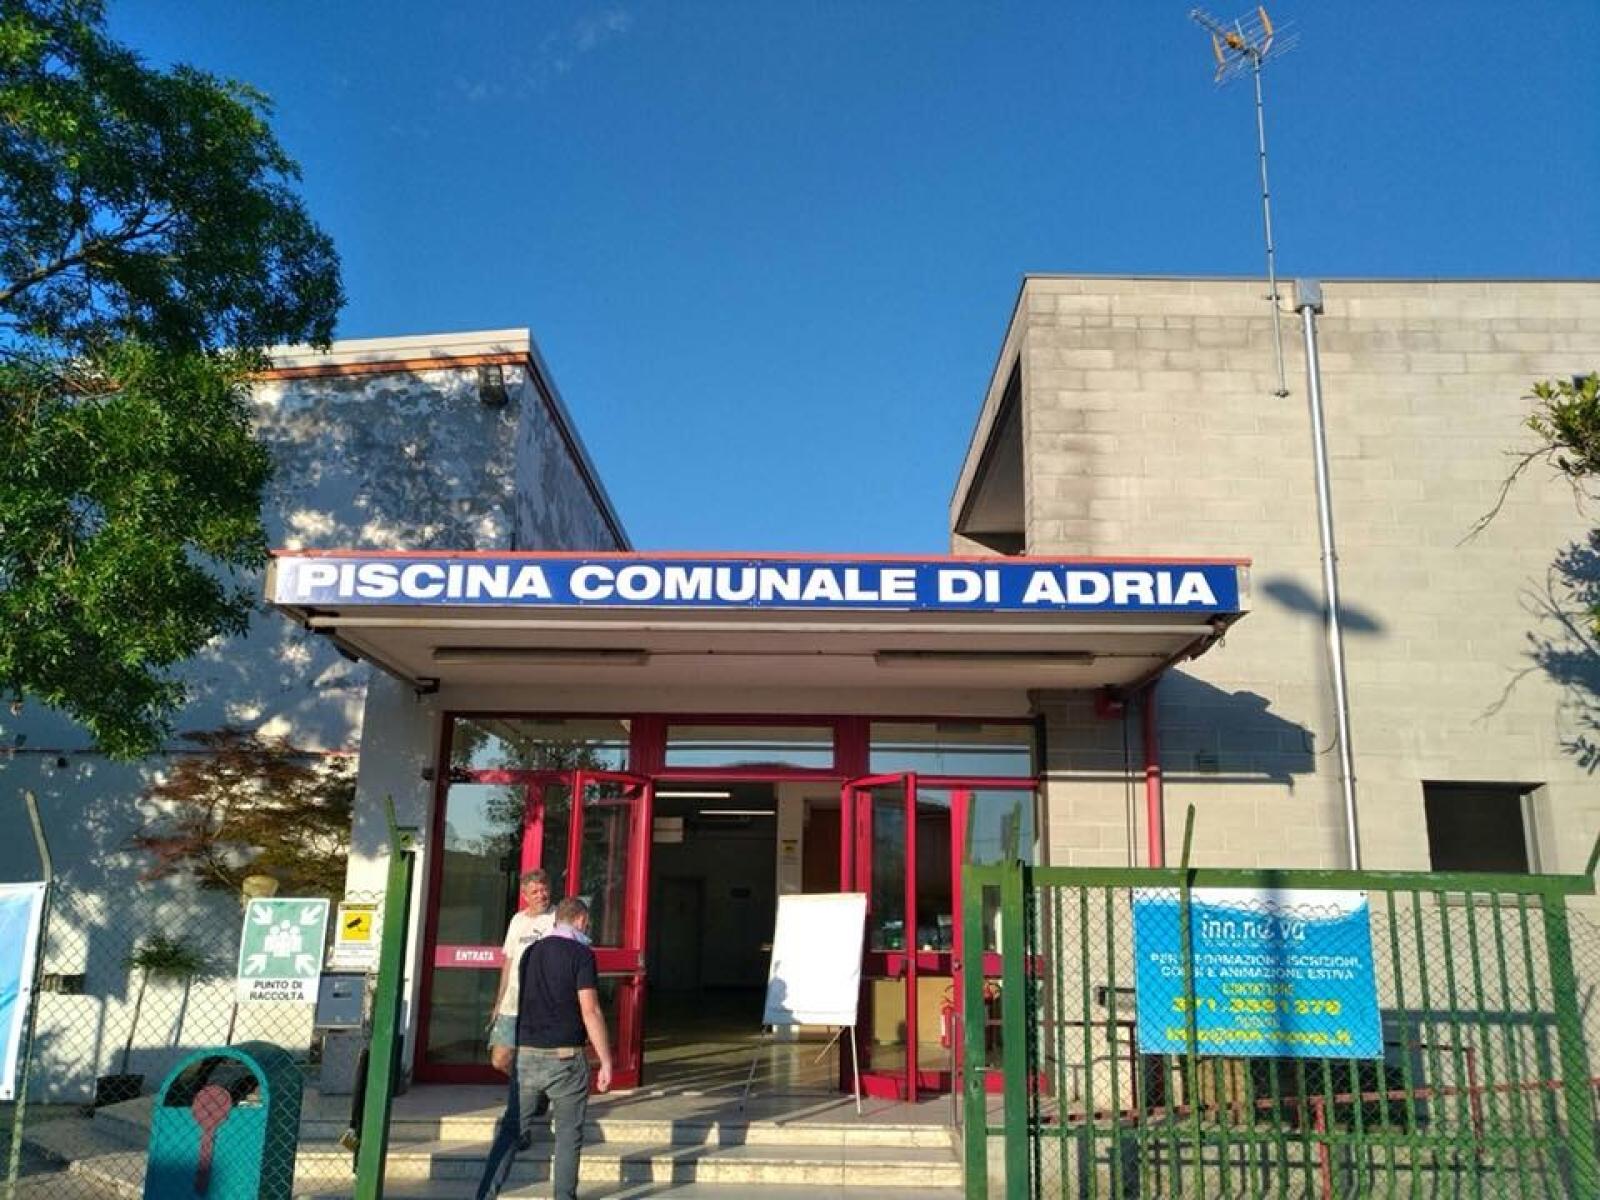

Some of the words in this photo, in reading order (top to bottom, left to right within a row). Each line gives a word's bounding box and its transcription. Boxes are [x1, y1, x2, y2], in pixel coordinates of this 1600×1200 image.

[300, 562, 551, 600] PISCINA
[569, 564, 917, 603] COMUNALE
[938, 569, 999, 603] DI
[1022, 570, 1217, 606] ADRIA
[454, 949, 495, 961] ENTRATA
[254, 979, 290, 990] PUNTO
[292, 980, 303, 989] DI
[249, 990, 305, 1001] RACCOLTA
